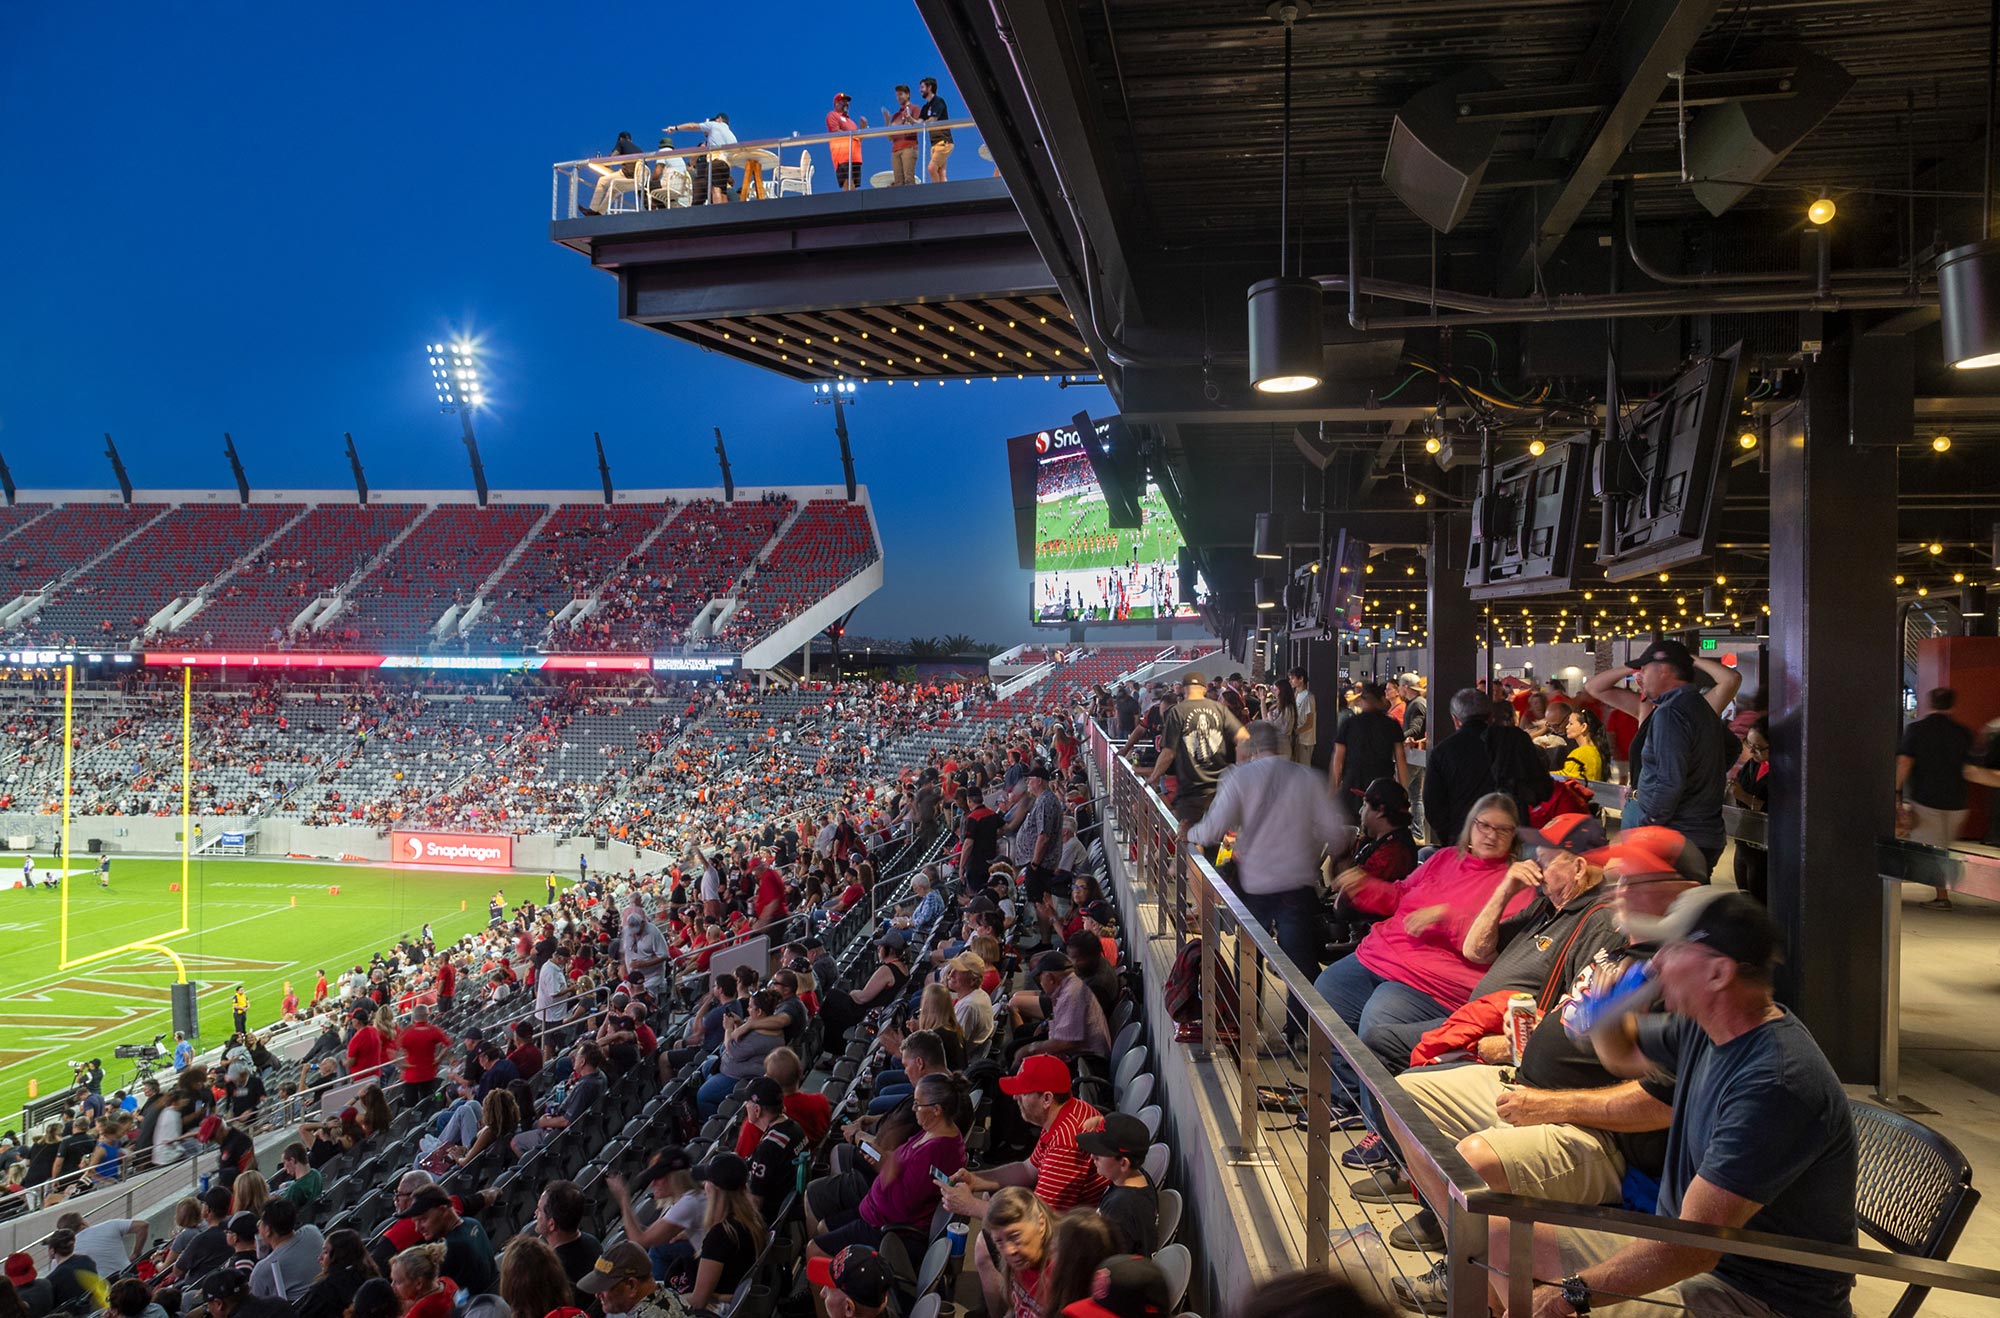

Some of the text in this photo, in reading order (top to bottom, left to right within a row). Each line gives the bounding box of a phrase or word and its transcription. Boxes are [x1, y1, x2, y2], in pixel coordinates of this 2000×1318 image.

[1703, 640, 1716, 650] EXIT
[432, 657, 502, 668] SAN DIEGO STATE
[1339, 670, 1349, 679] 116
[427, 842, 501, 861] Snapdragon
